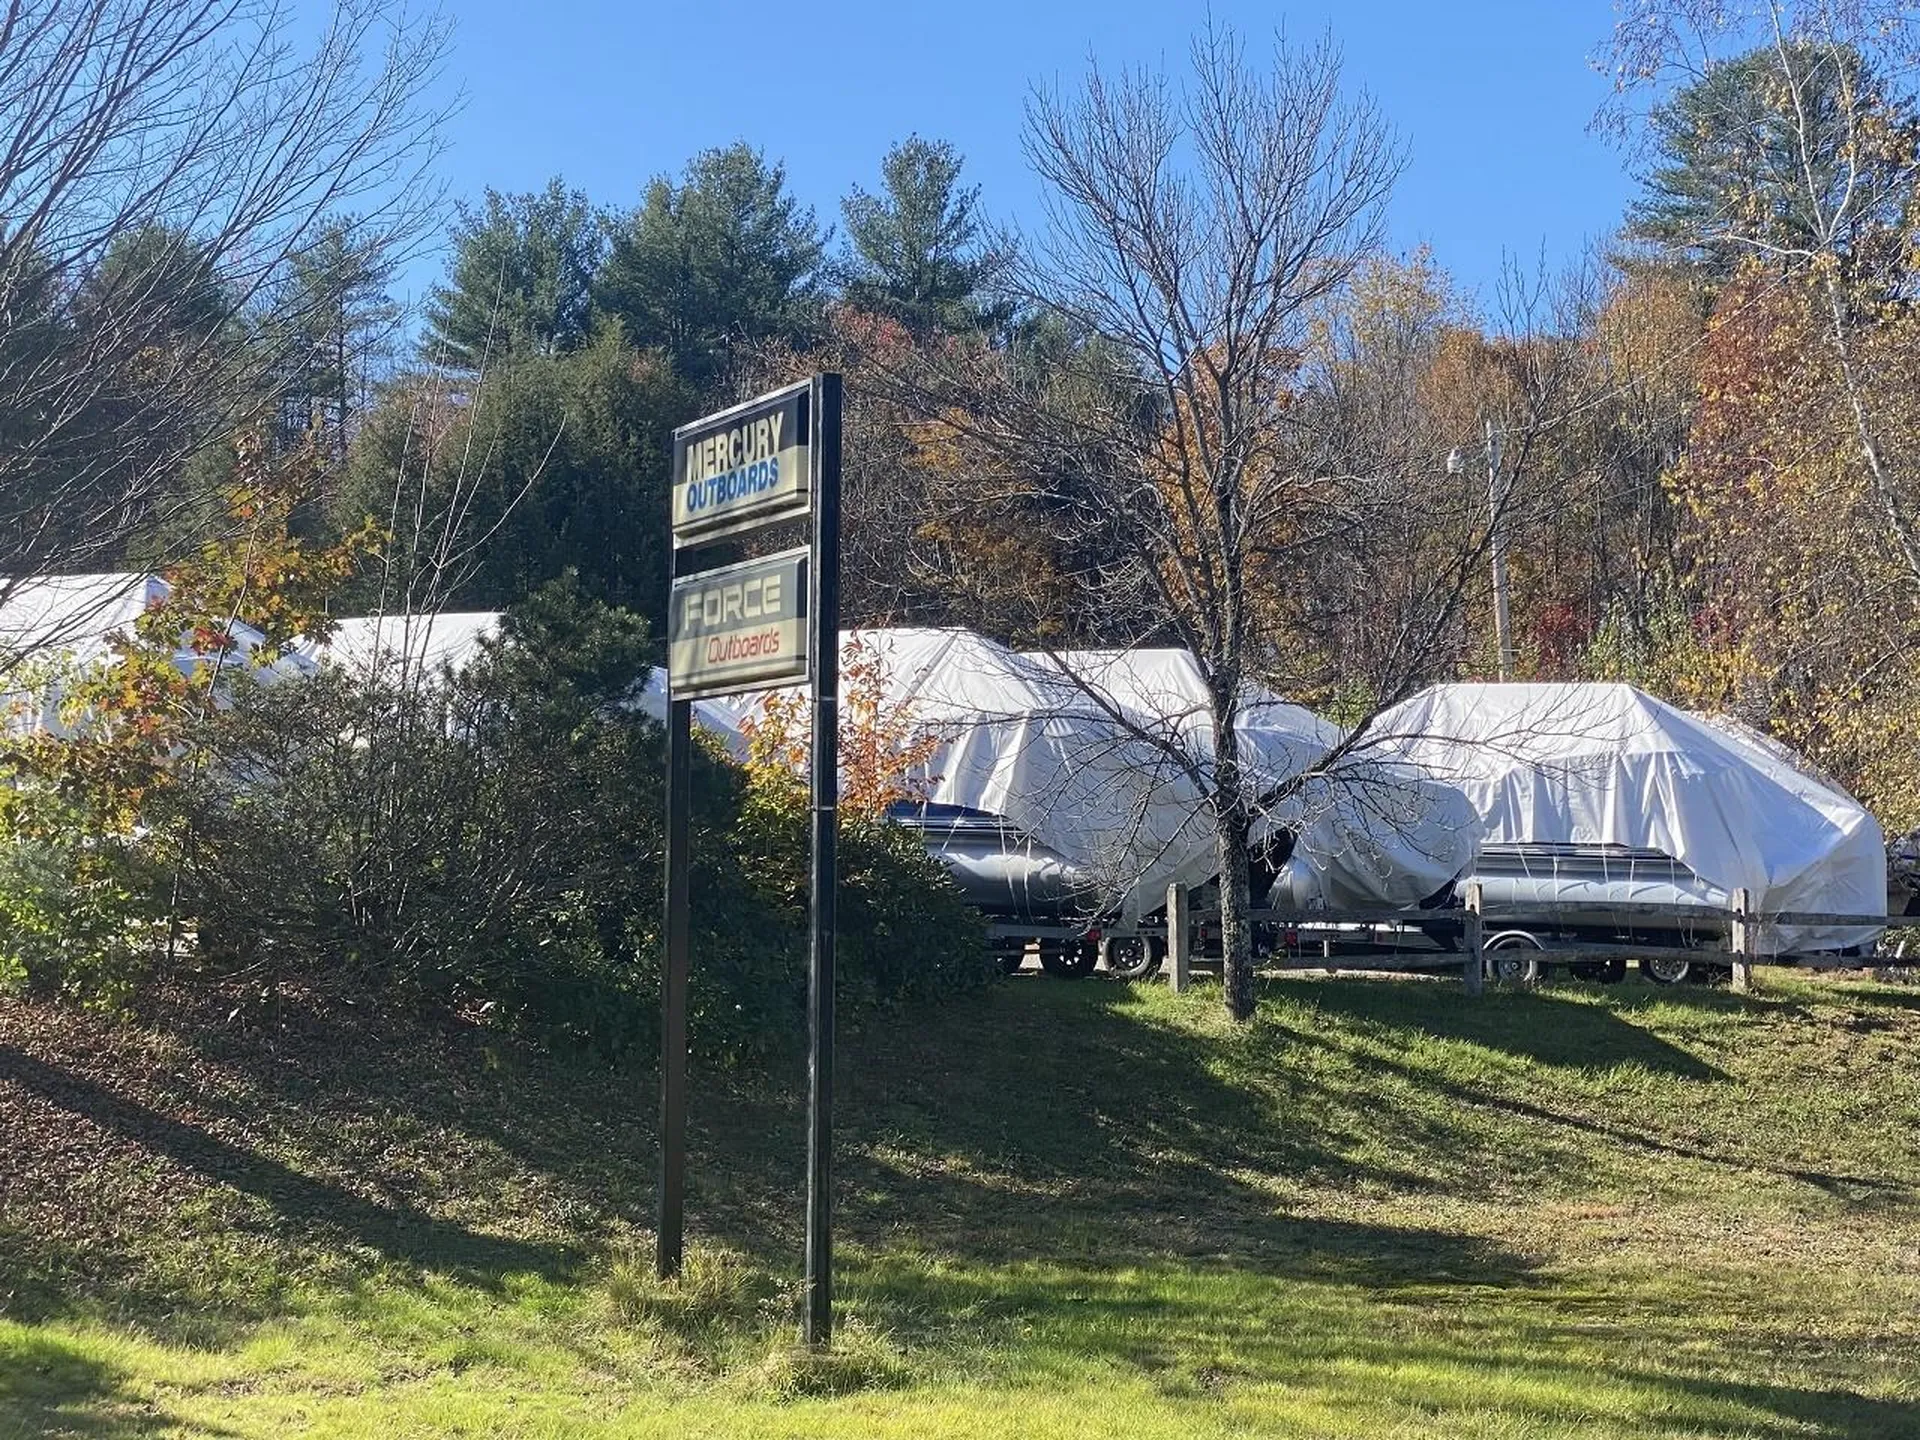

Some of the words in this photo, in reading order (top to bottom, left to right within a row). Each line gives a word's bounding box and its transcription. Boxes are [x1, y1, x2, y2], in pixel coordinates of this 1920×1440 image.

[686, 411, 784, 481] MERCURY
[687, 457, 779, 512] OUTBOARDS
[684, 574, 781, 630] FORCE
[707, 628, 780, 662] Outboards
